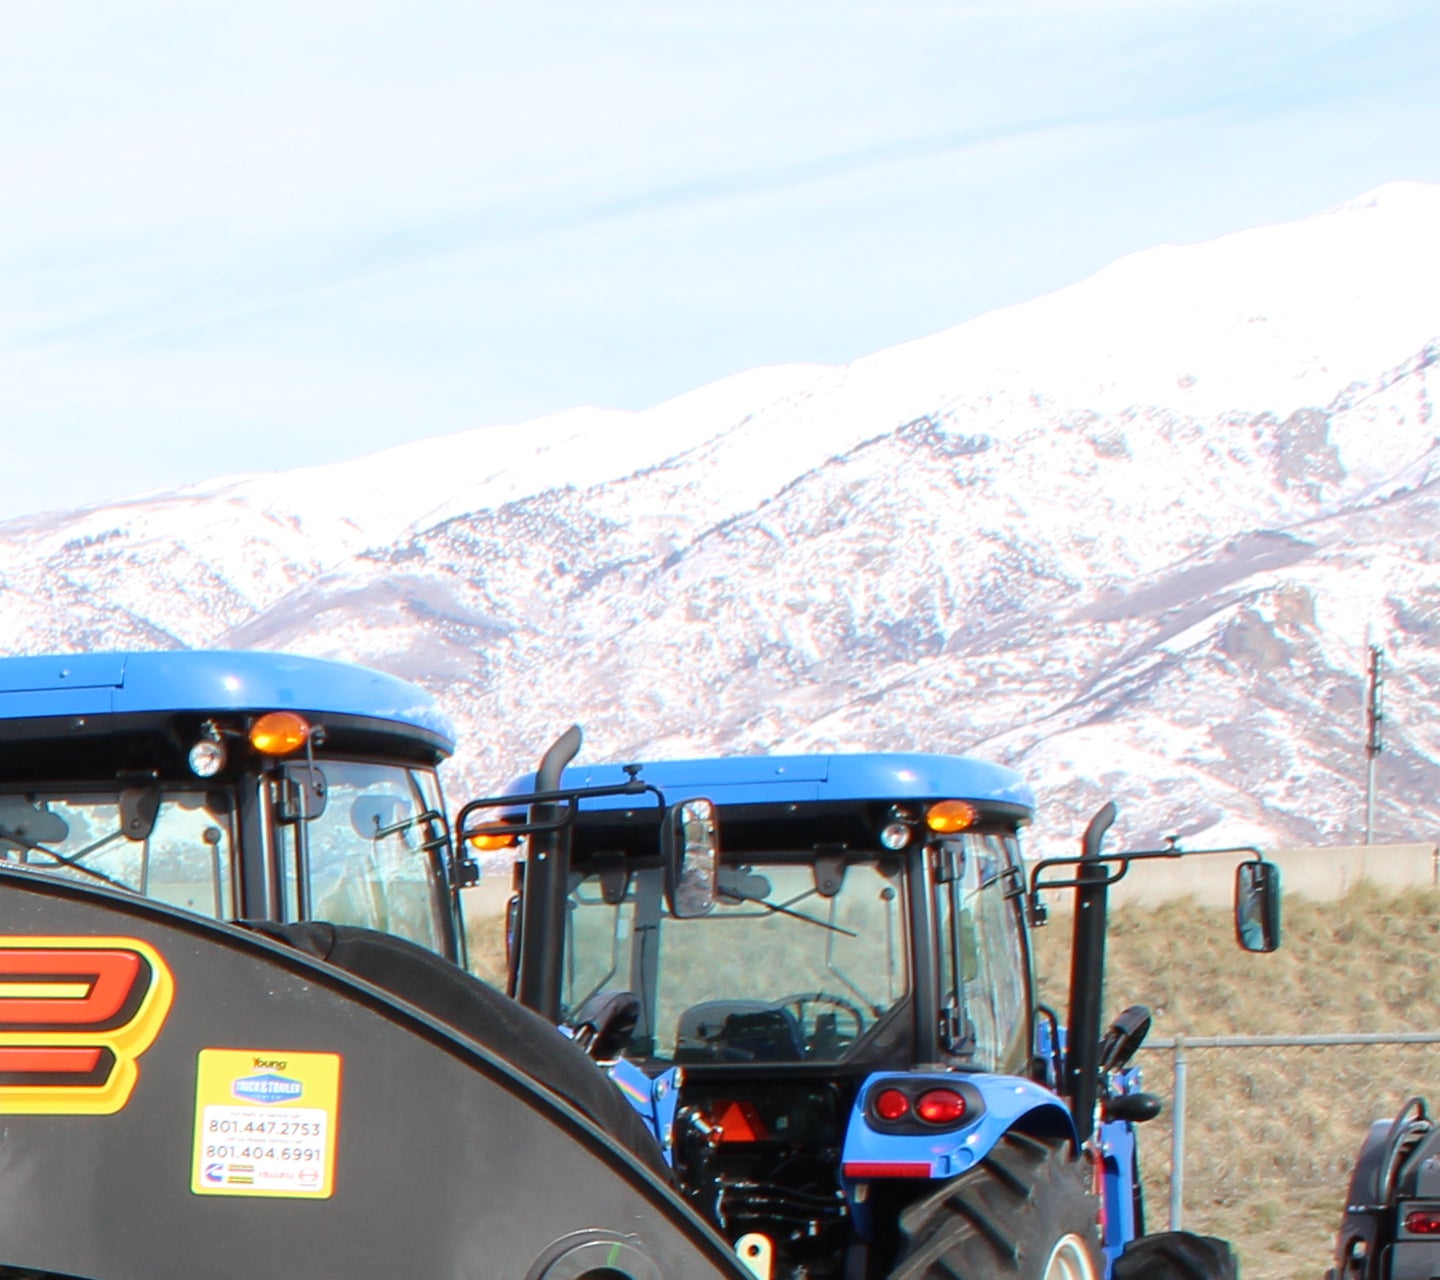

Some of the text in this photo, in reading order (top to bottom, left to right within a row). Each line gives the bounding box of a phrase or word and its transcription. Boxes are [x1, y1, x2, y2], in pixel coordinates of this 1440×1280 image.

[253, 1057, 288, 1071] Young
[209, 1120, 320, 1135] 801.447.2753
[206, 1146, 320, 1161] 801.404.6991
